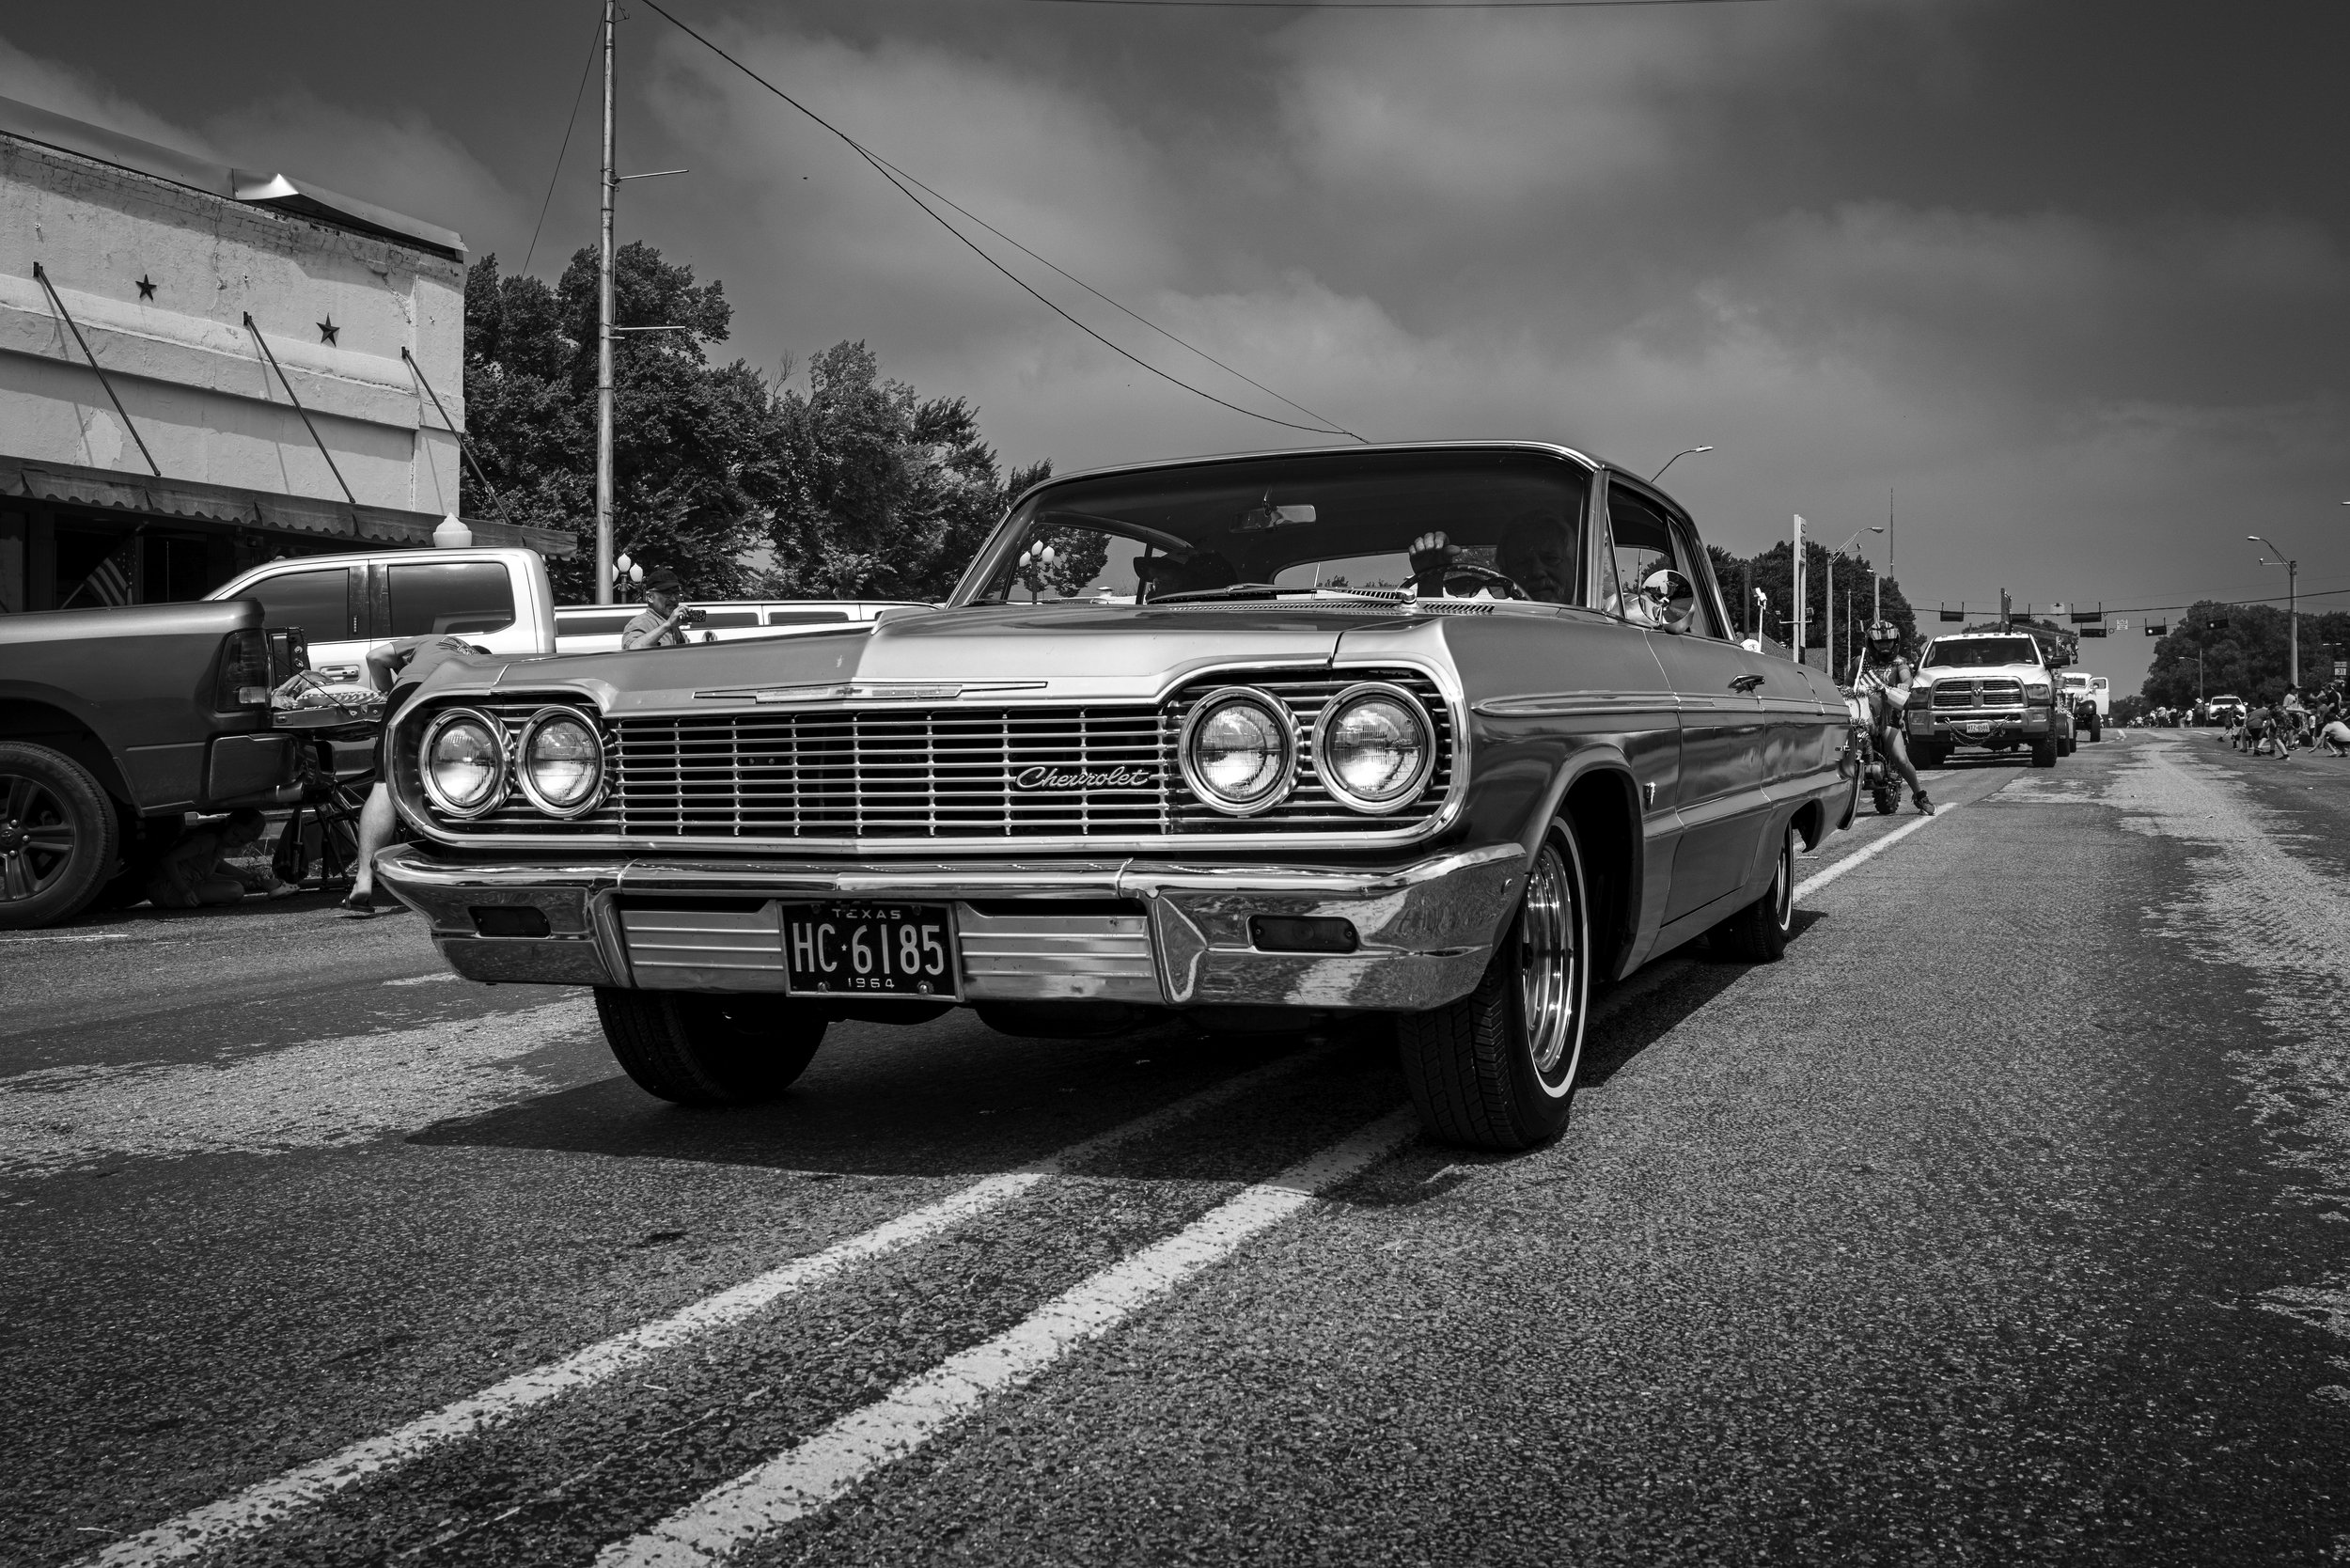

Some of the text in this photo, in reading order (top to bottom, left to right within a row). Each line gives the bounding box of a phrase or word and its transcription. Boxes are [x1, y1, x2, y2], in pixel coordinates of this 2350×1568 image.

[1017, 765, 1150, 788] Chevrolet
[832, 908, 901, 919] TEXAS
[848, 978, 895, 989] 1964
